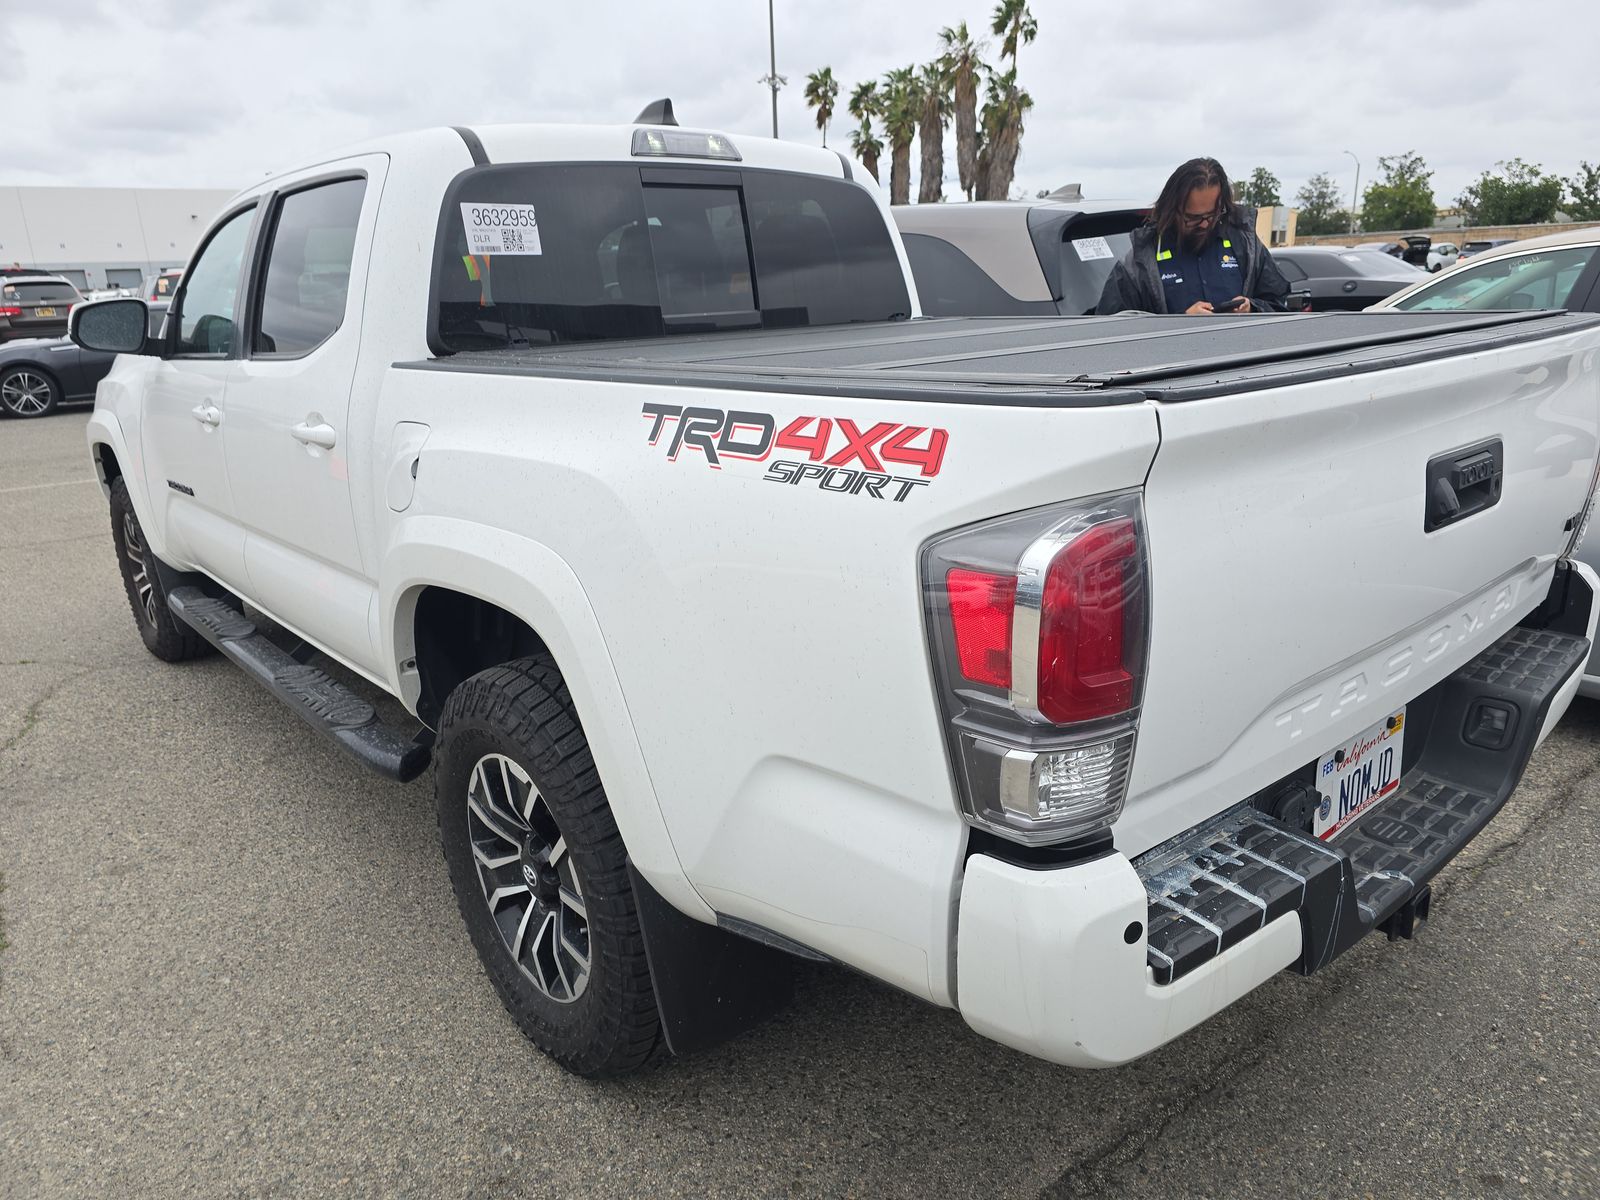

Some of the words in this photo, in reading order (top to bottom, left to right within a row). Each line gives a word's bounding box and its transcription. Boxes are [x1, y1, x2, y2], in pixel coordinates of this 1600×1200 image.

[471, 208, 538, 227] 3632959
[473, 234, 491, 243] DLR
[641, 402, 777, 471] TRD
[774, 416, 950, 477] 4X4
[763, 459, 931, 503] SPORT
[1274, 583, 1514, 739] TACOMA
[1322, 759, 1334, 777] FEB
[1336, 727, 1390, 772] California
[1338, 747, 1394, 821] NOMJD
